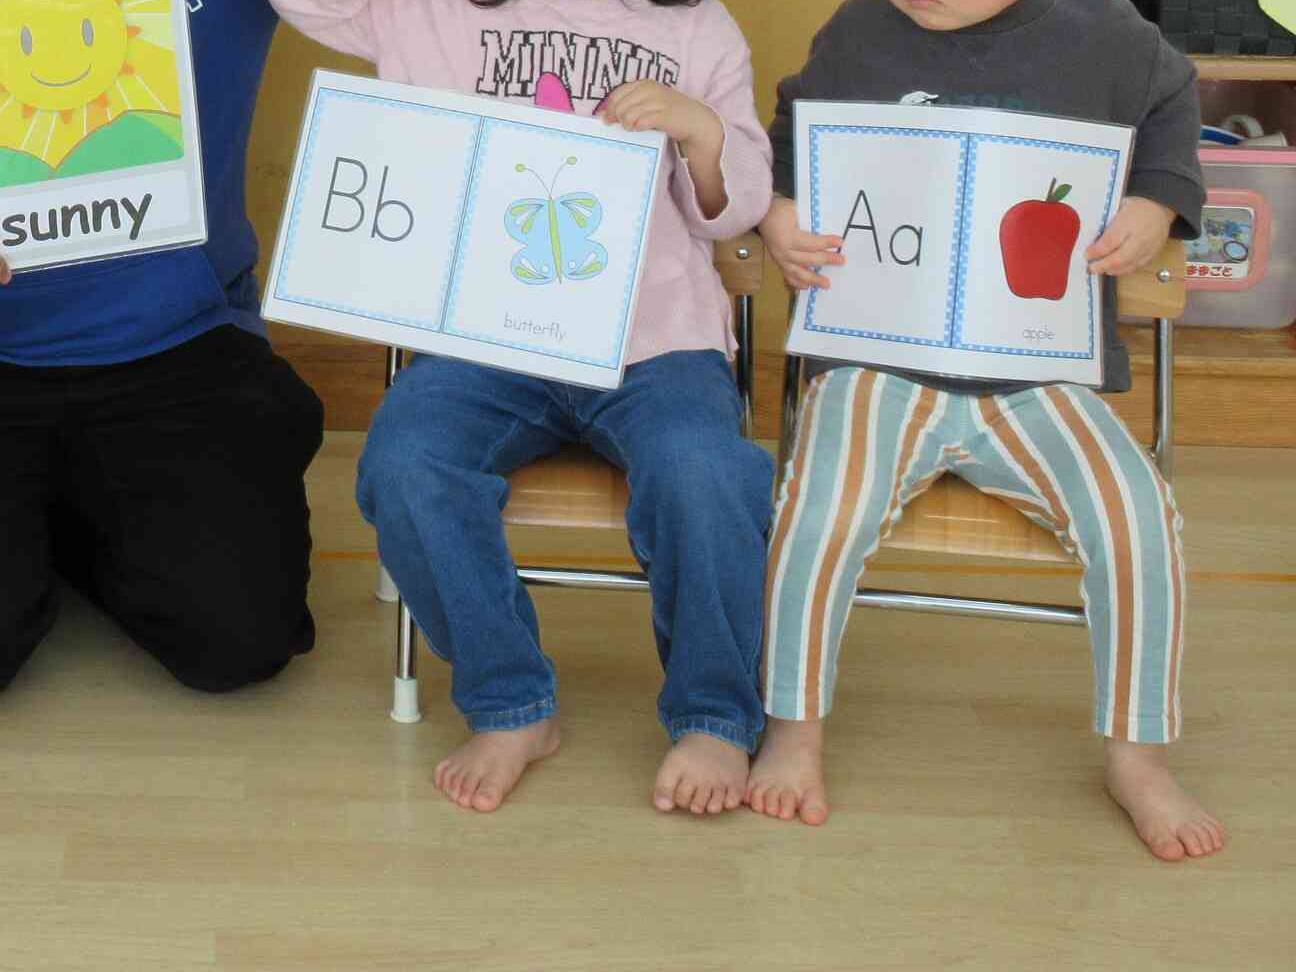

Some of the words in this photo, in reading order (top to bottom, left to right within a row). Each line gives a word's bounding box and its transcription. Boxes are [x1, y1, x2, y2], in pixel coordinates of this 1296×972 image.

[1, 193, 153, 247] sunny
[321, 156, 415, 243] Bb
[836, 189, 924, 268] Aa
[504, 310, 568, 343] butterfly
[1022, 324, 1057, 342] apple
